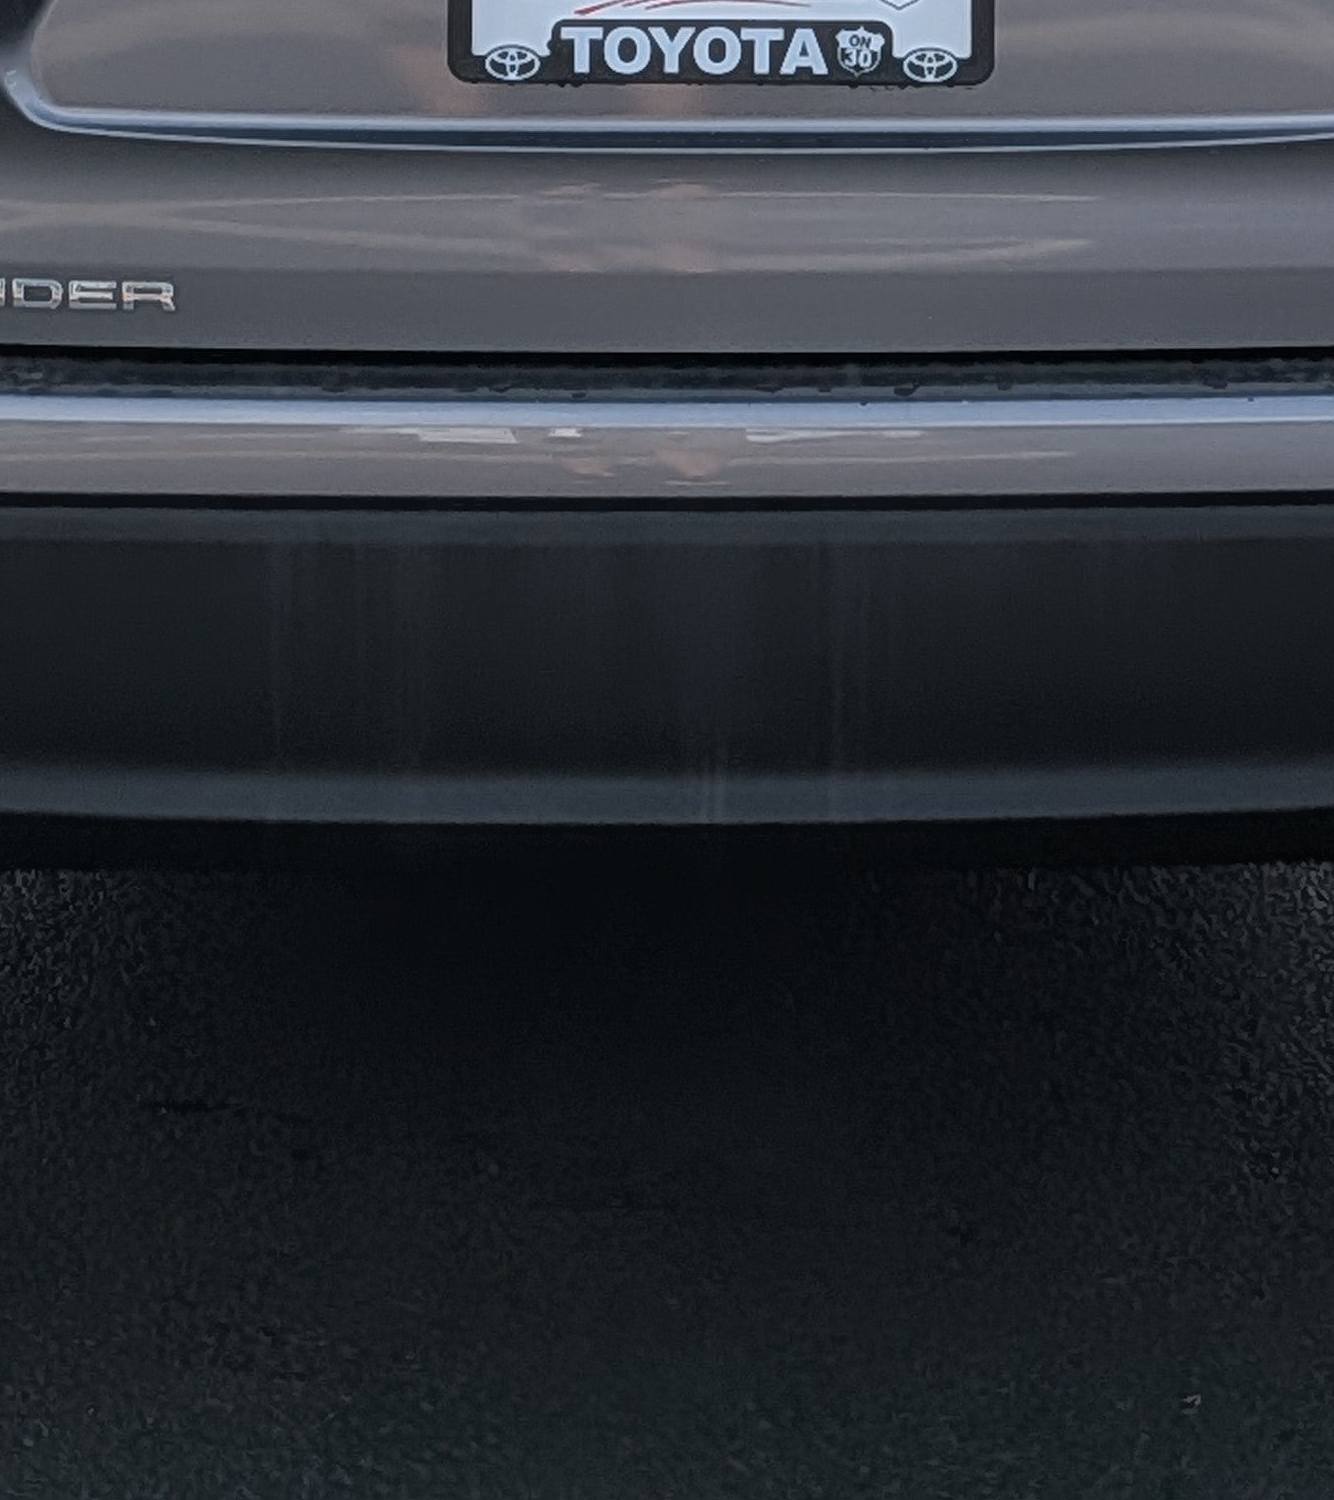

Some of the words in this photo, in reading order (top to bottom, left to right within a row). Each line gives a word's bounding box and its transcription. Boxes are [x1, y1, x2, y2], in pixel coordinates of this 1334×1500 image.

[560, 27, 828, 76] TOYOTA
[848, 34, 872, 49] ON
[844, 48, 873, 68] 30
